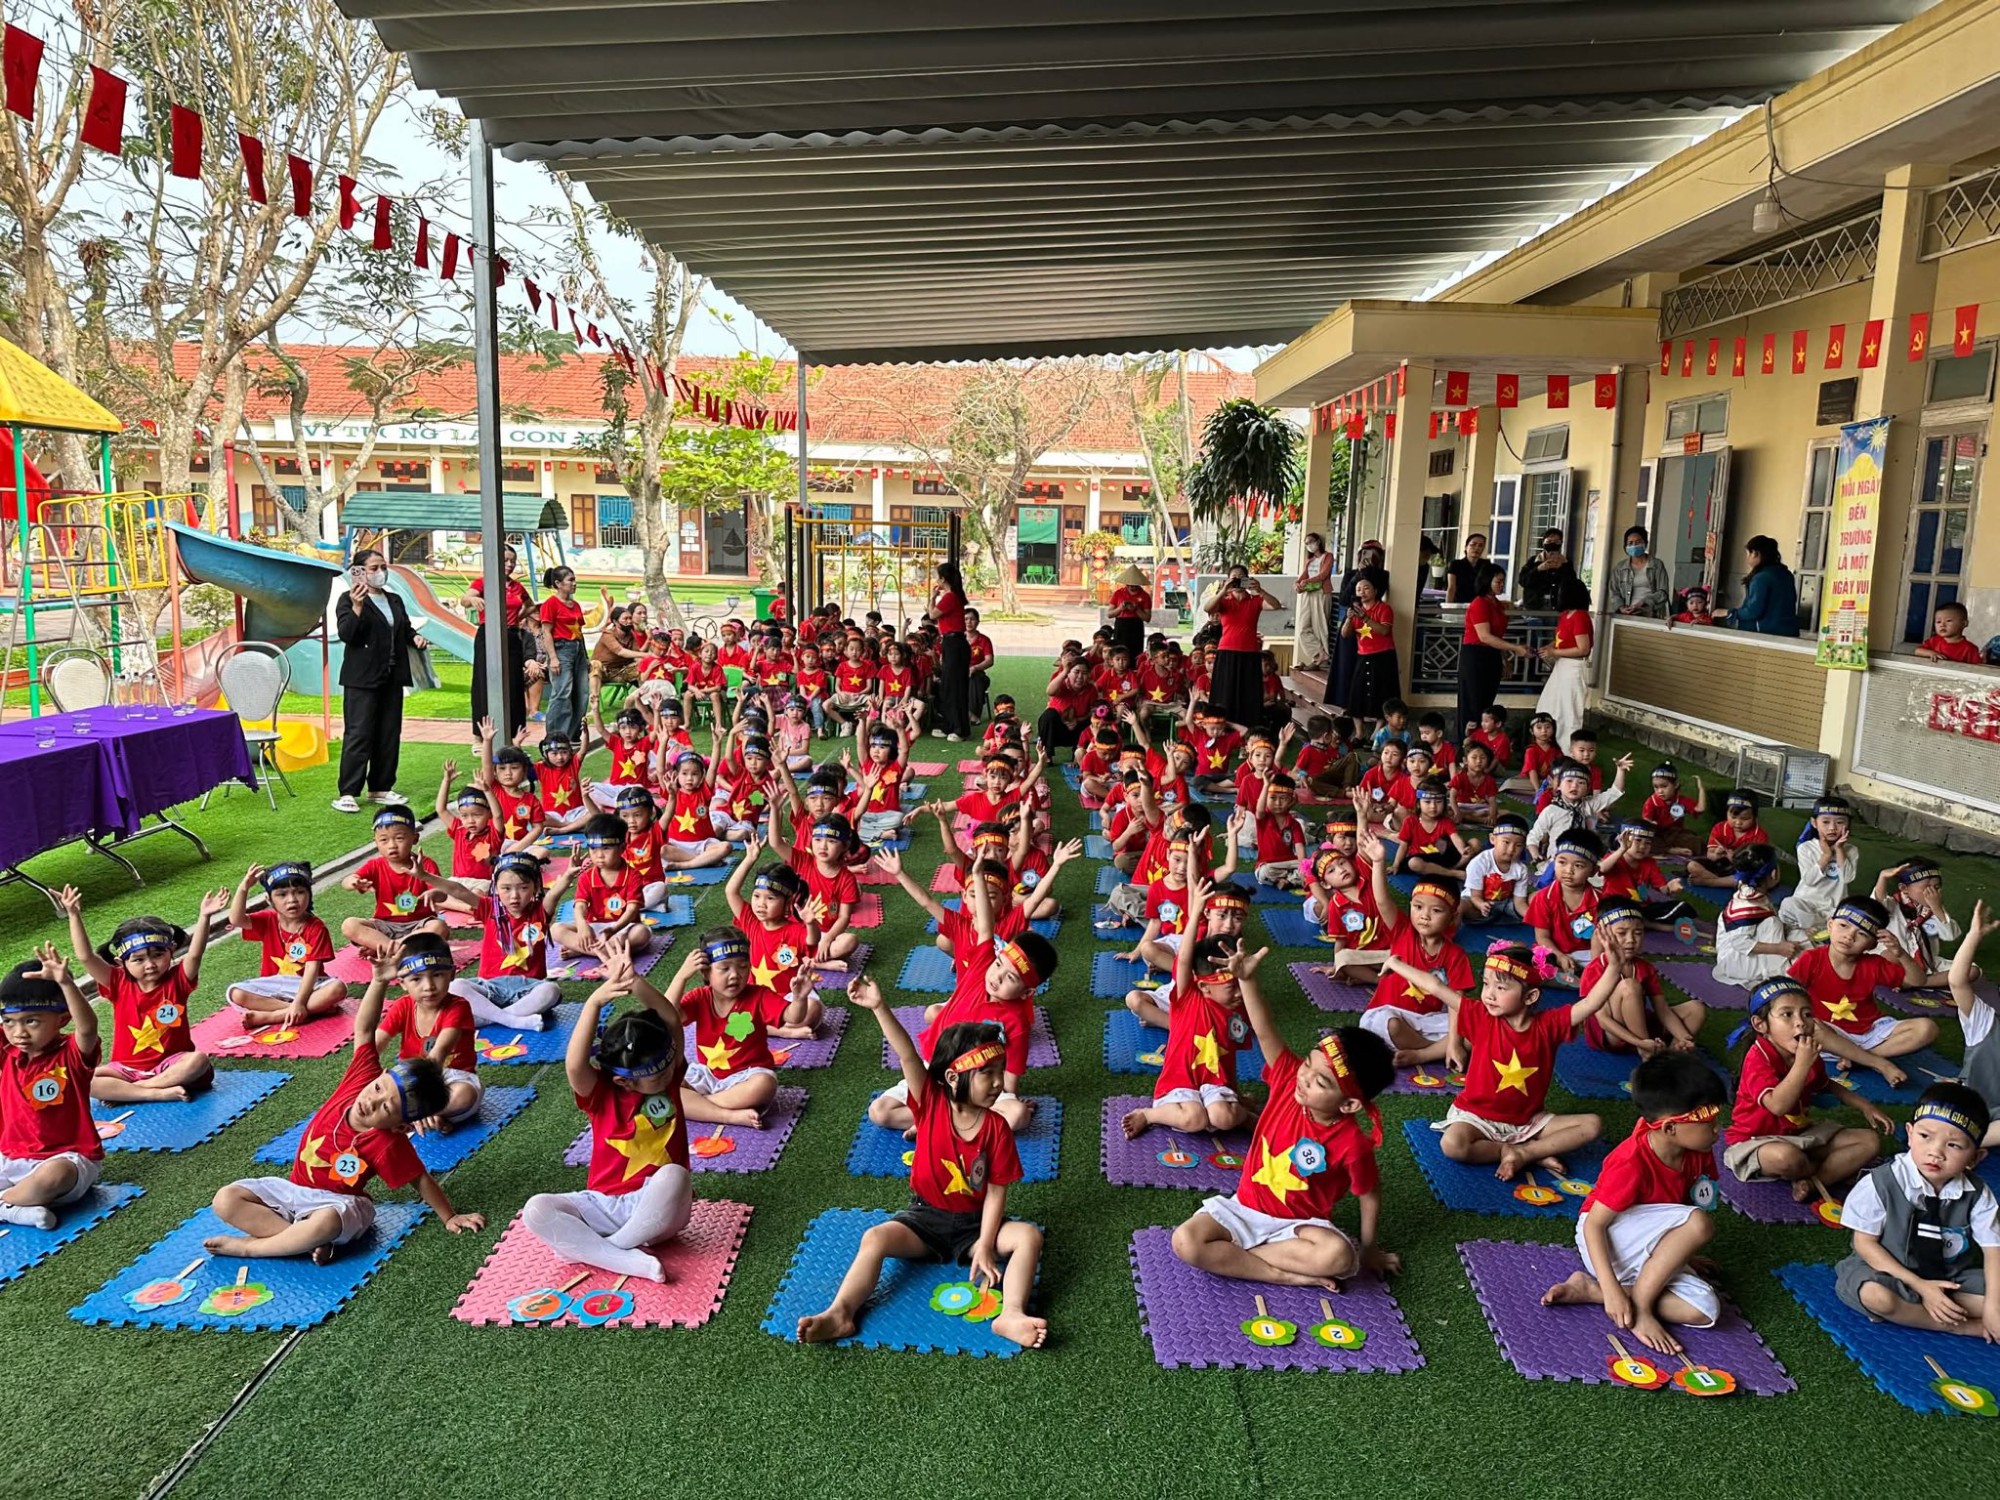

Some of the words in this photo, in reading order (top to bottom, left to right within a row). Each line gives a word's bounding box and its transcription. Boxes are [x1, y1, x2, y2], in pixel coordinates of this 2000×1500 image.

[509, 430, 567, 443] CON
[1848, 502, 1867, 521] ĐẾN
[1838, 553, 1847, 570] LÀ
[1850, 553, 1868, 573] MỘT
[1832, 578, 1855, 595] NGÀY
[1856, 579, 1870, 594] VUI
[610, 901, 619, 909] 11
[290, 945, 303, 956] 26
[723, 943, 732, 955] LÀ
[779, 951, 793, 963] 28
[1760, 988, 1770, 1000] BÉ
[1767, 983, 1779, 995] VỚI
[1777, 982, 1788, 992] AN
[159, 1007, 174, 1018] 24
[1232, 1023, 1242, 1032] 54
[973, 1051, 984, 1063] AN
[37, 1082, 56, 1097] 16
[648, 1098, 667, 1113] 04
[1922, 1104, 1933, 1115] AN
[1931, 1104, 1952, 1119] TOÀN
[1951, 1111, 1969, 1127] GIAO
[1302, 1149, 1317, 1166] 38
[340, 1159, 356, 1173] 23
[1699, 1187, 1710, 1198] 41
[1331, 1330, 1343, 1340] 2
[1629, 1364, 1643, 1376] 2
